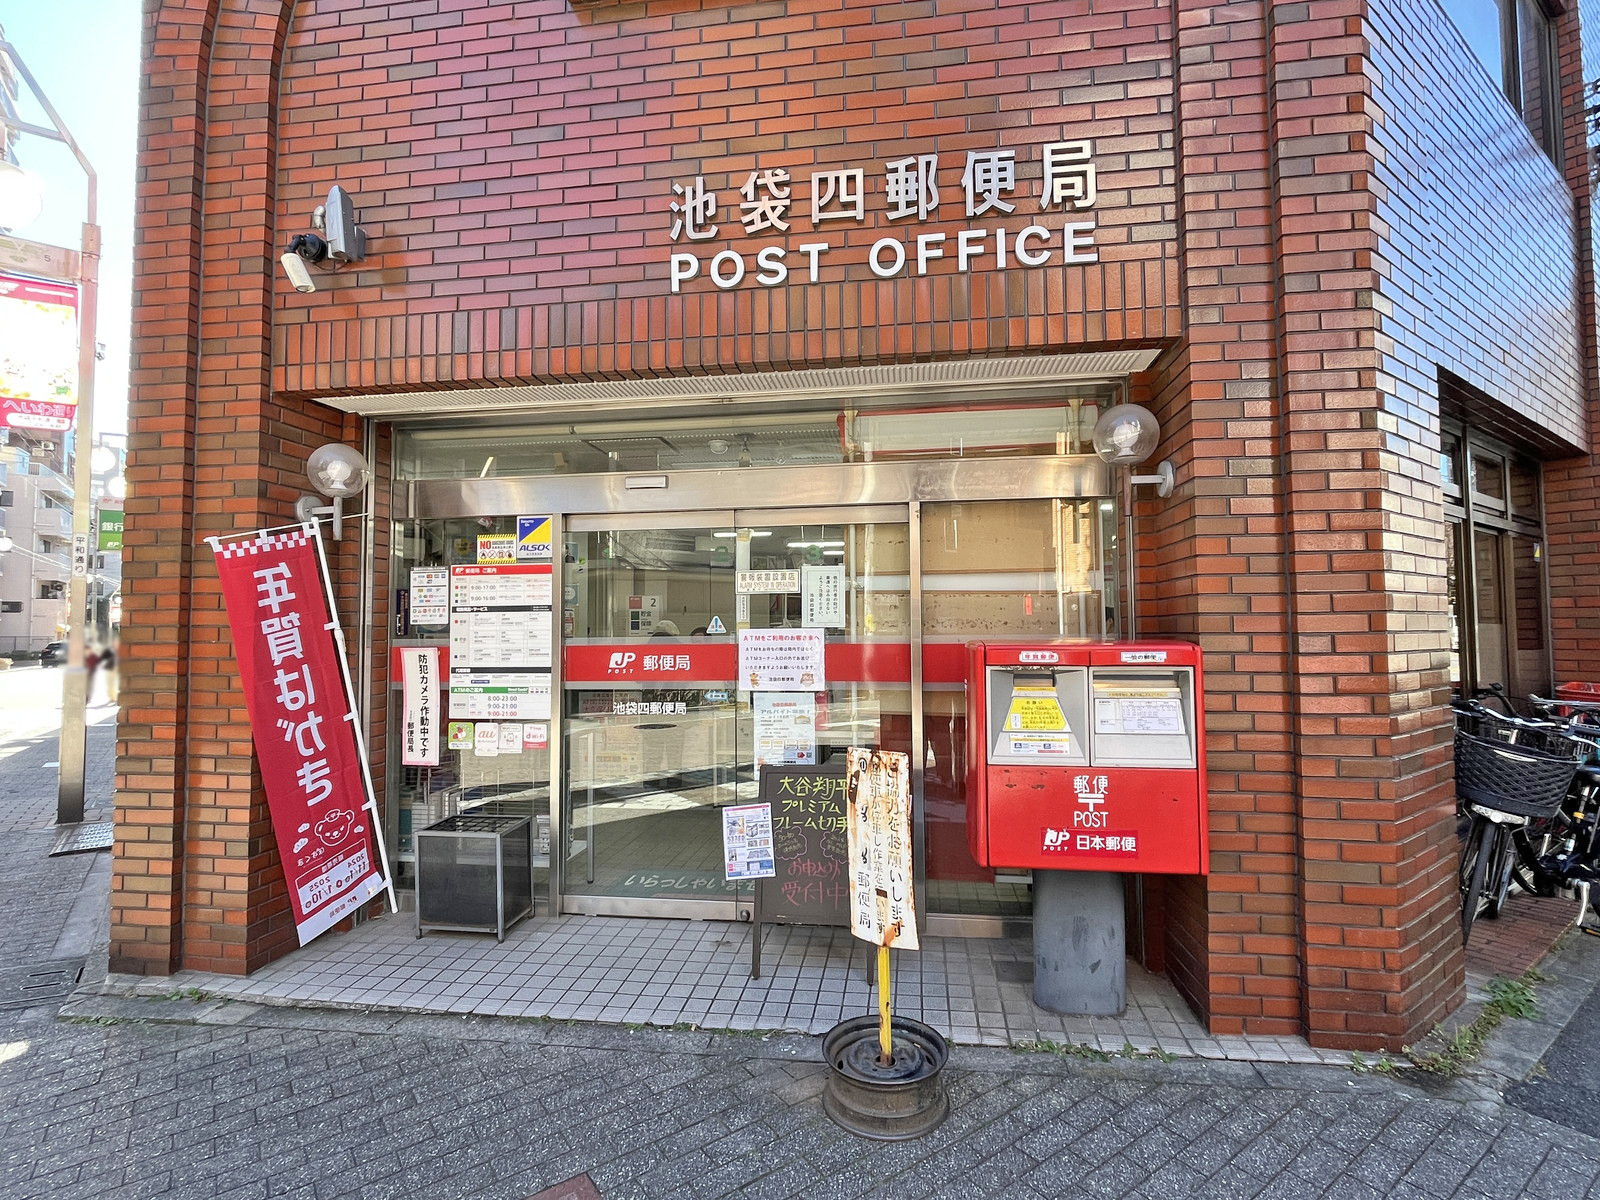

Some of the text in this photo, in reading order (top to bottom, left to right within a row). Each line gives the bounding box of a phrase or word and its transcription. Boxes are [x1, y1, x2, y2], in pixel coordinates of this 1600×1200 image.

[669, 140, 1097, 242] 池袋四郵便局
[670, 221, 1099, 293] POST OFFICE
[480, 540, 492, 550] NO
[74, 536, 85, 573] 平和通り
[650, 598, 657, 607] 2
[608, 652, 636, 669] JP
[643, 655, 691, 671] 郵便局
[418, 654, 429, 758] 防犯カメラ作動中です
[612, 702, 687, 715] 池袋四郵便局
[478, 729, 497, 738] au
[777, 776, 848, 800] 大谷翔平
[1073, 775, 1109, 794] 郵便
[782, 799, 842, 815] プレミアム
[773, 815, 848, 834] フレーム切手
[1073, 811, 1109, 828] POST
[1044, 828, 1071, 846] JP
[1076, 835, 1137, 852] 日本郵便
[781, 880, 849, 911] 受付中
